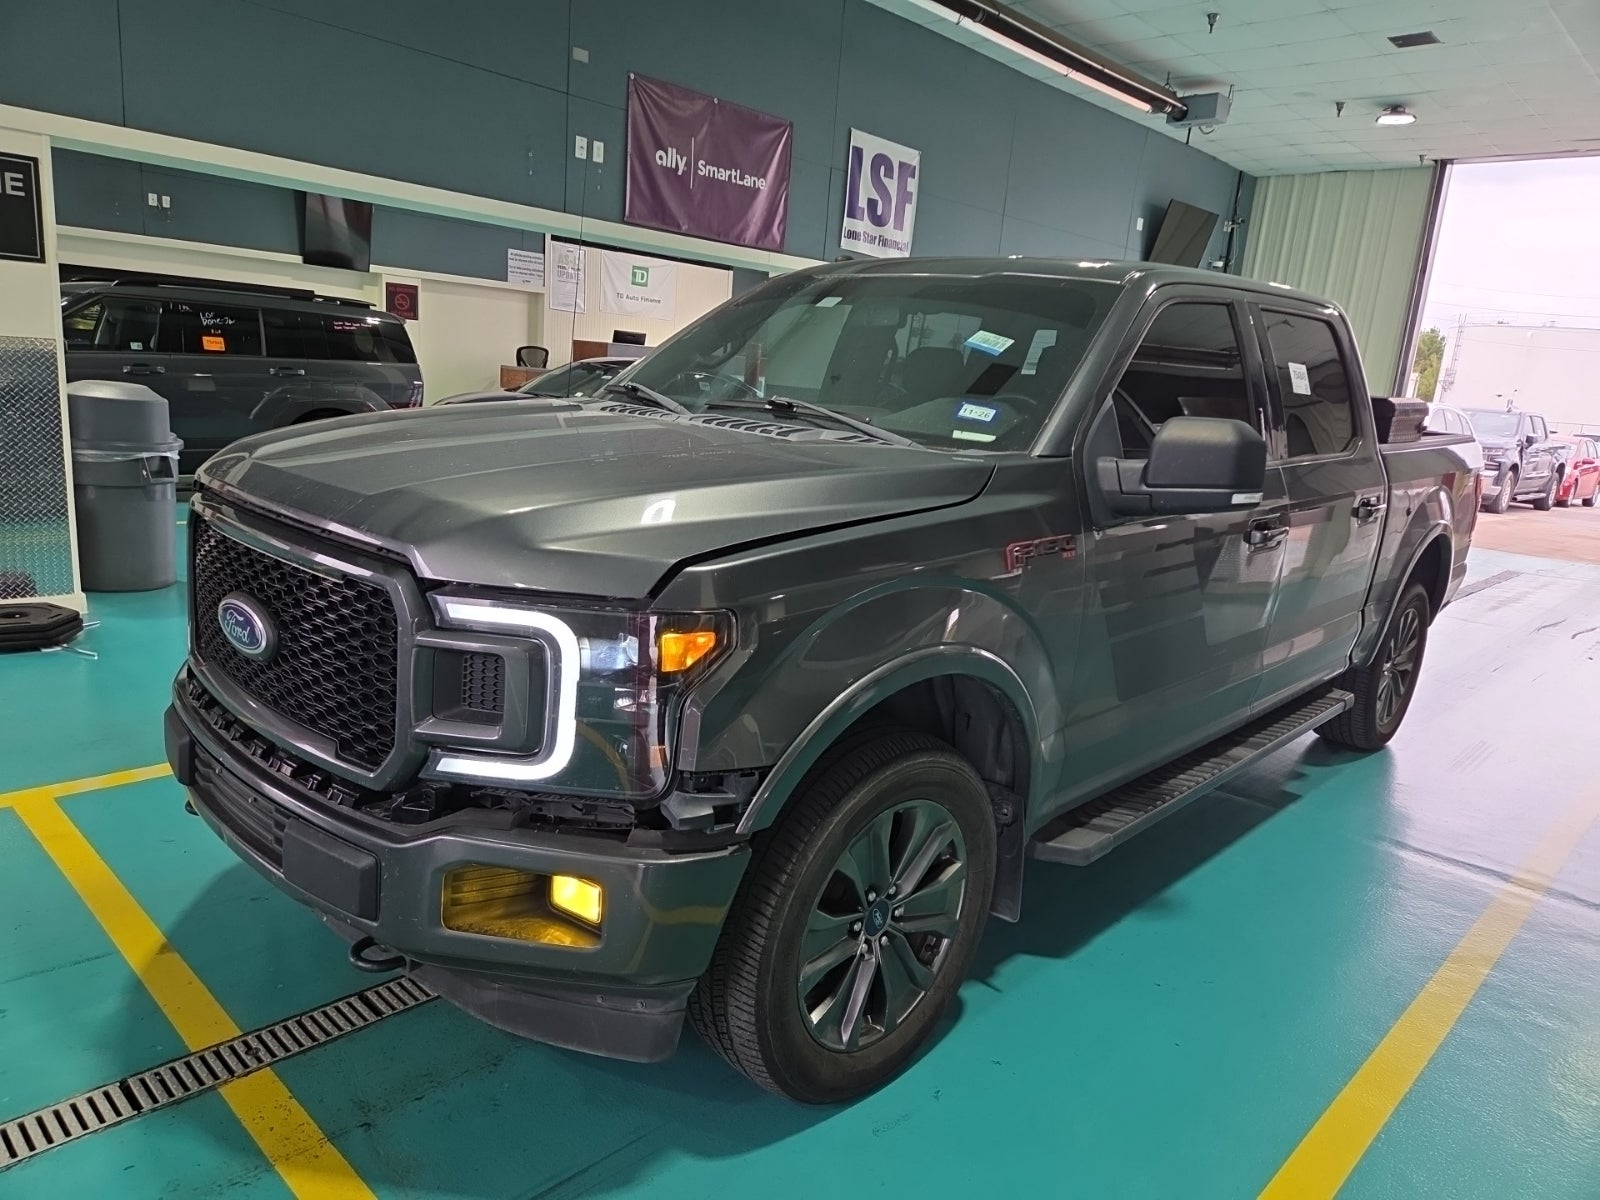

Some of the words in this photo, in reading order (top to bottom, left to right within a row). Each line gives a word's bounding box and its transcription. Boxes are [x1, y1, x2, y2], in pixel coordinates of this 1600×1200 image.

[655, 146, 687, 176] ally
[697, 159, 766, 190] SmartLane
[0, 172, 26, 197] E
[846, 145, 917, 232] LSF
[843, 226, 862, 242] Lone
[862, 231, 878, 246] Star
[877, 234, 909, 252] Financial
[633, 269, 648, 283] TD
[224, 609, 251, 643] Ford
